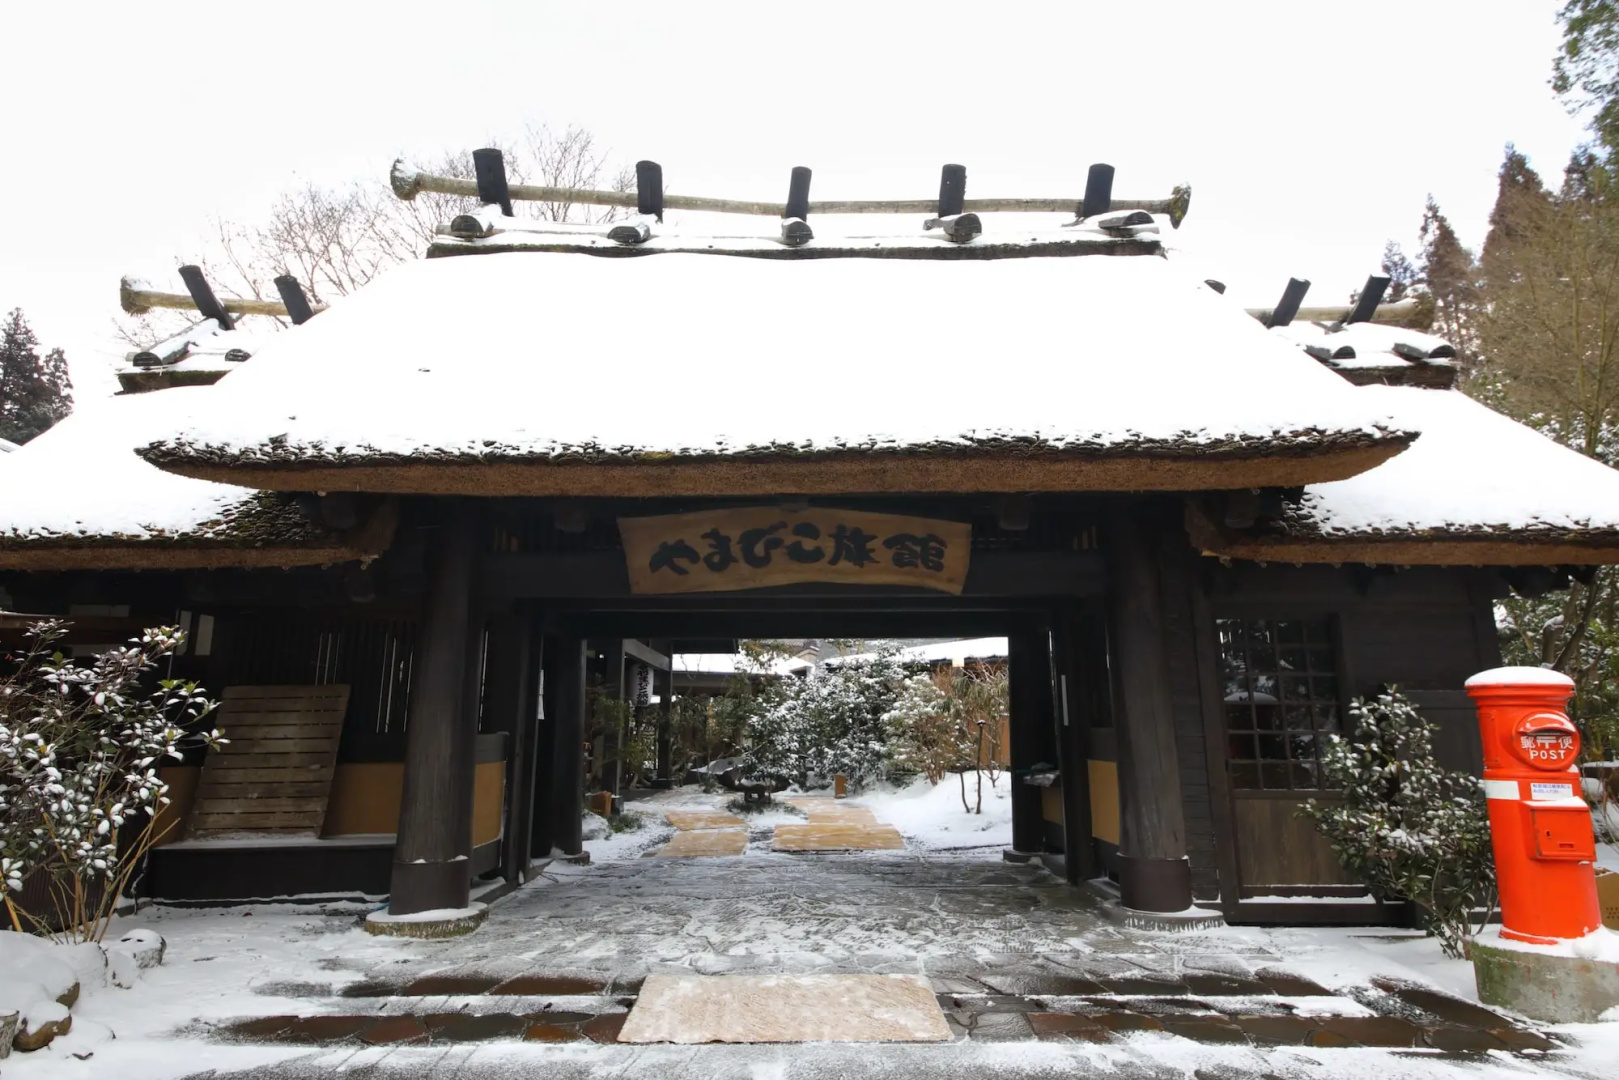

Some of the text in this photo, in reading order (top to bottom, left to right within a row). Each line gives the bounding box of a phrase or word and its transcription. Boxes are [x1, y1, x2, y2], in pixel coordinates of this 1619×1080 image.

[649, 521, 948, 575] やまびこ旅館
[1530, 750, 1566, 760] POST
